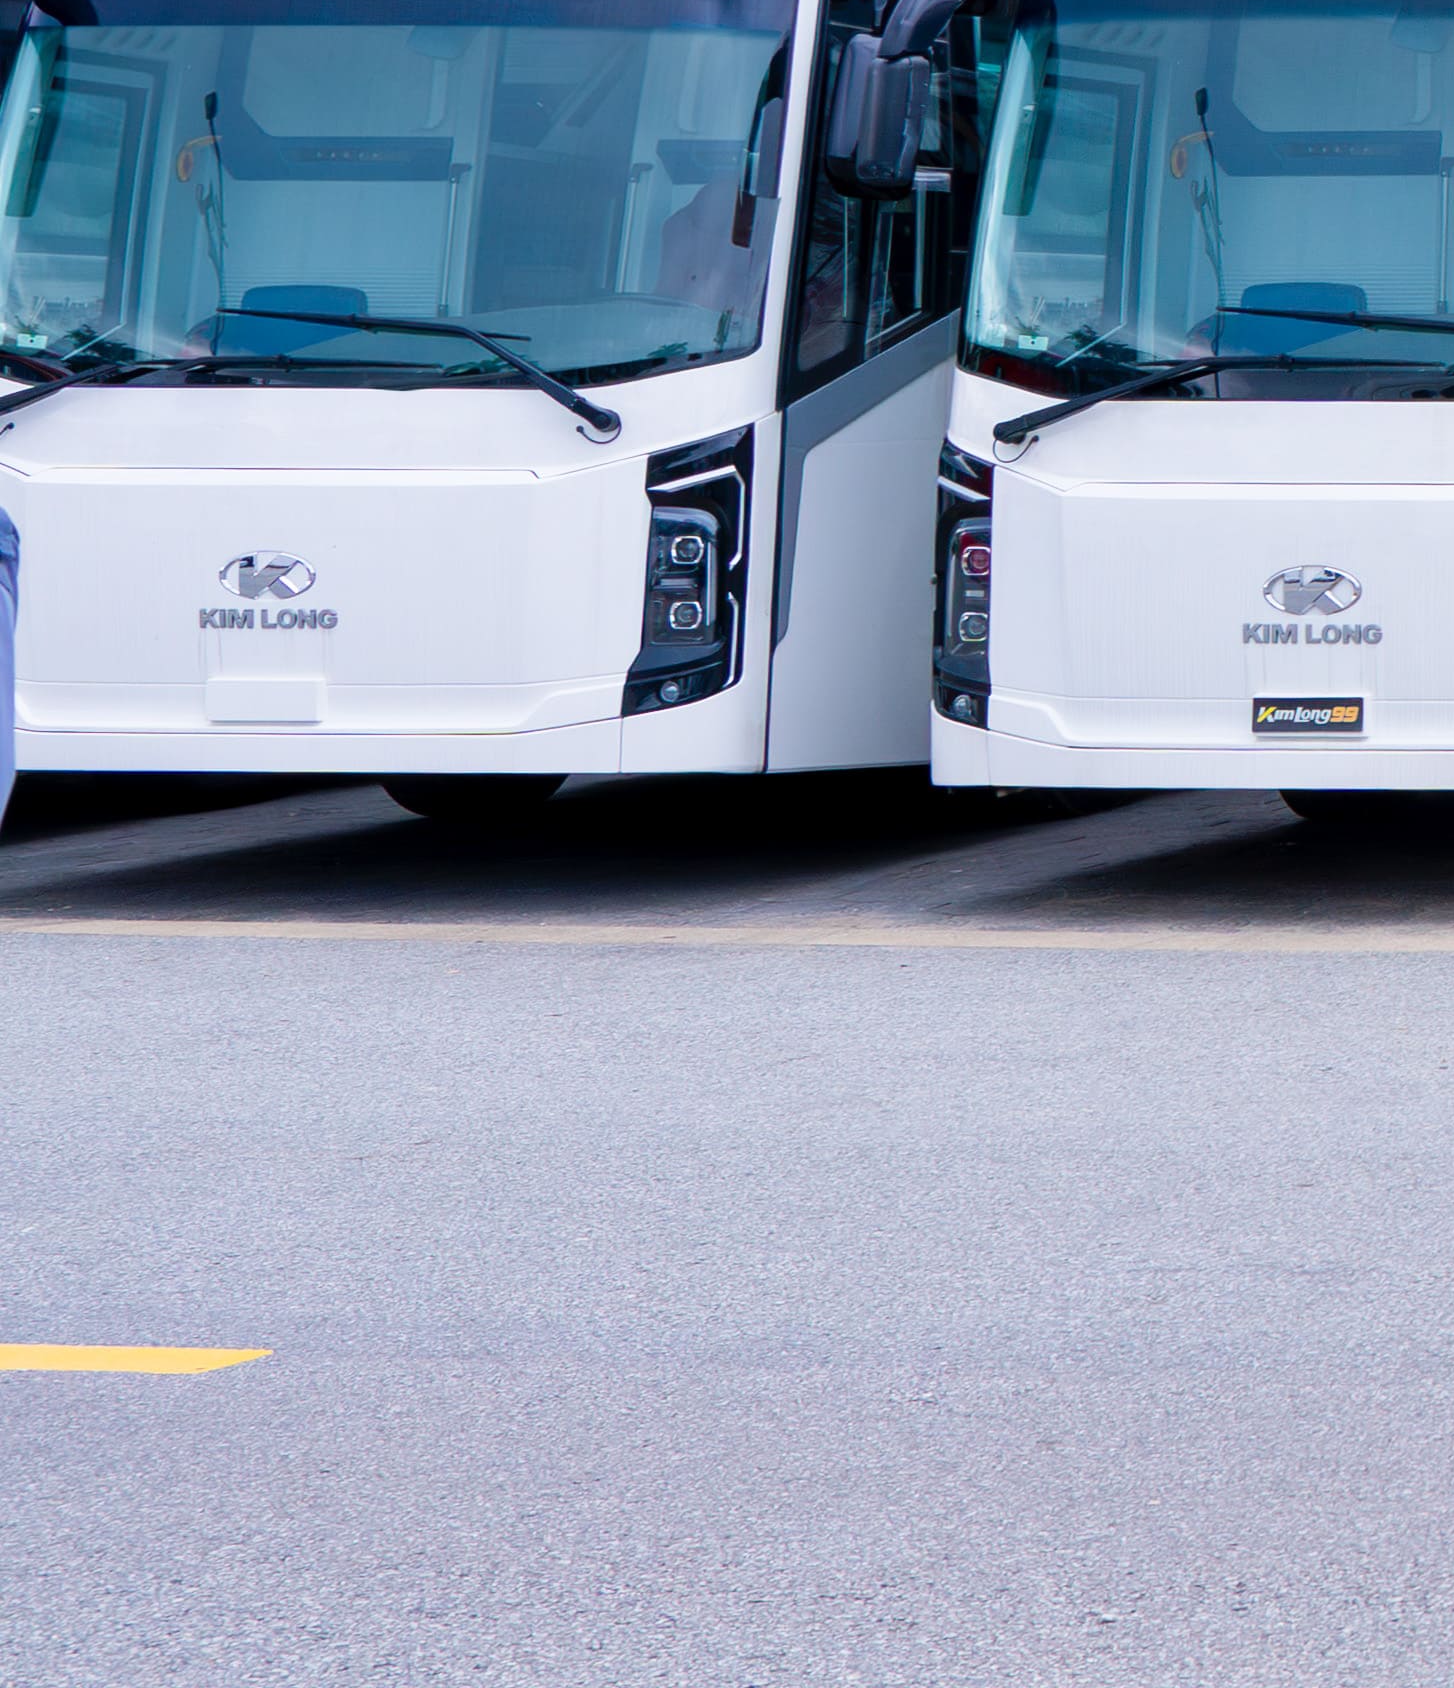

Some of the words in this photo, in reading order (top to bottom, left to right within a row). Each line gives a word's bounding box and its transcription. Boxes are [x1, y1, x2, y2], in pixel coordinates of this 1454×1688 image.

[199, 608, 255, 630] KIM
[260, 608, 339, 630] LONG
[1242, 623, 1299, 645] KIM
[1304, 623, 1383, 645] LONG
[1256, 706, 1360, 725] KimLong99
